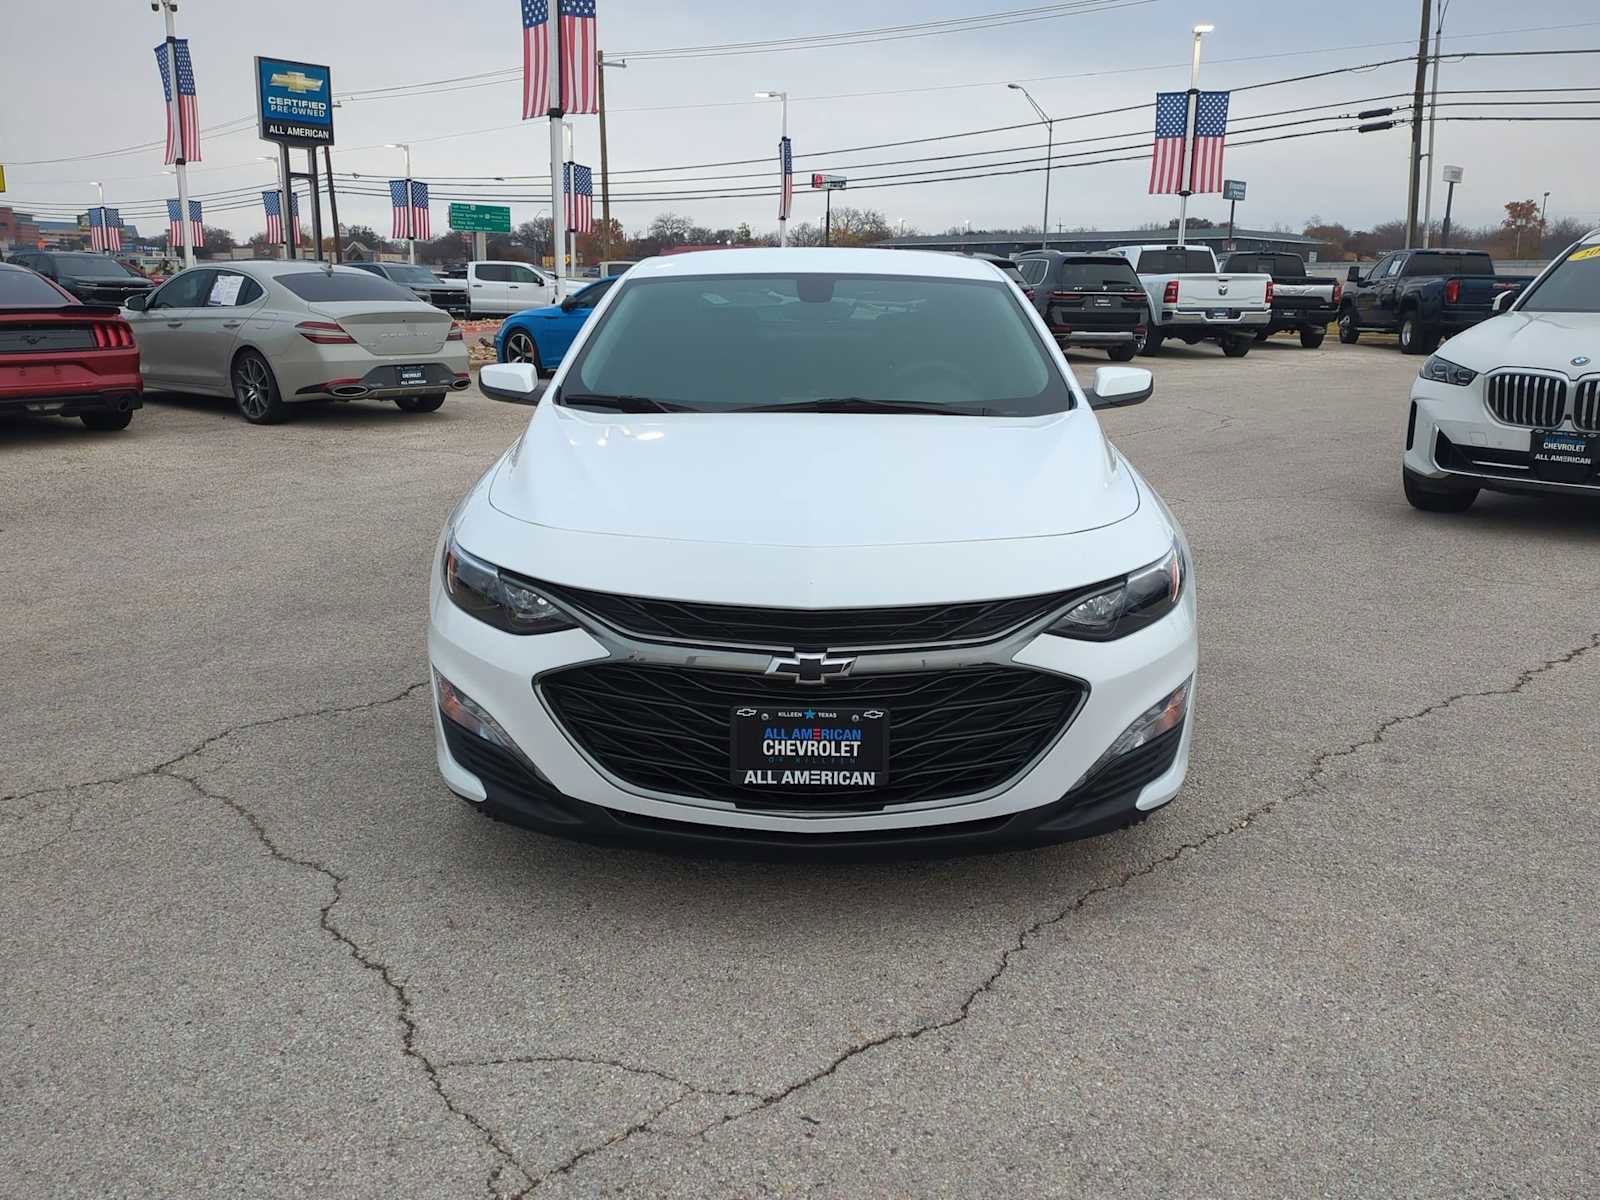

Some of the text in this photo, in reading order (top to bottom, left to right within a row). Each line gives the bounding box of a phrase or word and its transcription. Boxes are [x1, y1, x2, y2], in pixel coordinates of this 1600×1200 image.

[268, 96, 326, 110] CERTIFIED
[271, 104, 325, 117] PRE-OWNED
[269, 125, 329, 139] ALL AMERICAN
[1543, 442, 1585, 452] CHEVROLET
[1535, 453, 1591, 464] ALL AMERICAN
[764, 728, 862, 741] ALL AMERICAN
[763, 740, 861, 757] CHEVROLET
[744, 770, 876, 786] ALL AMERICAN
